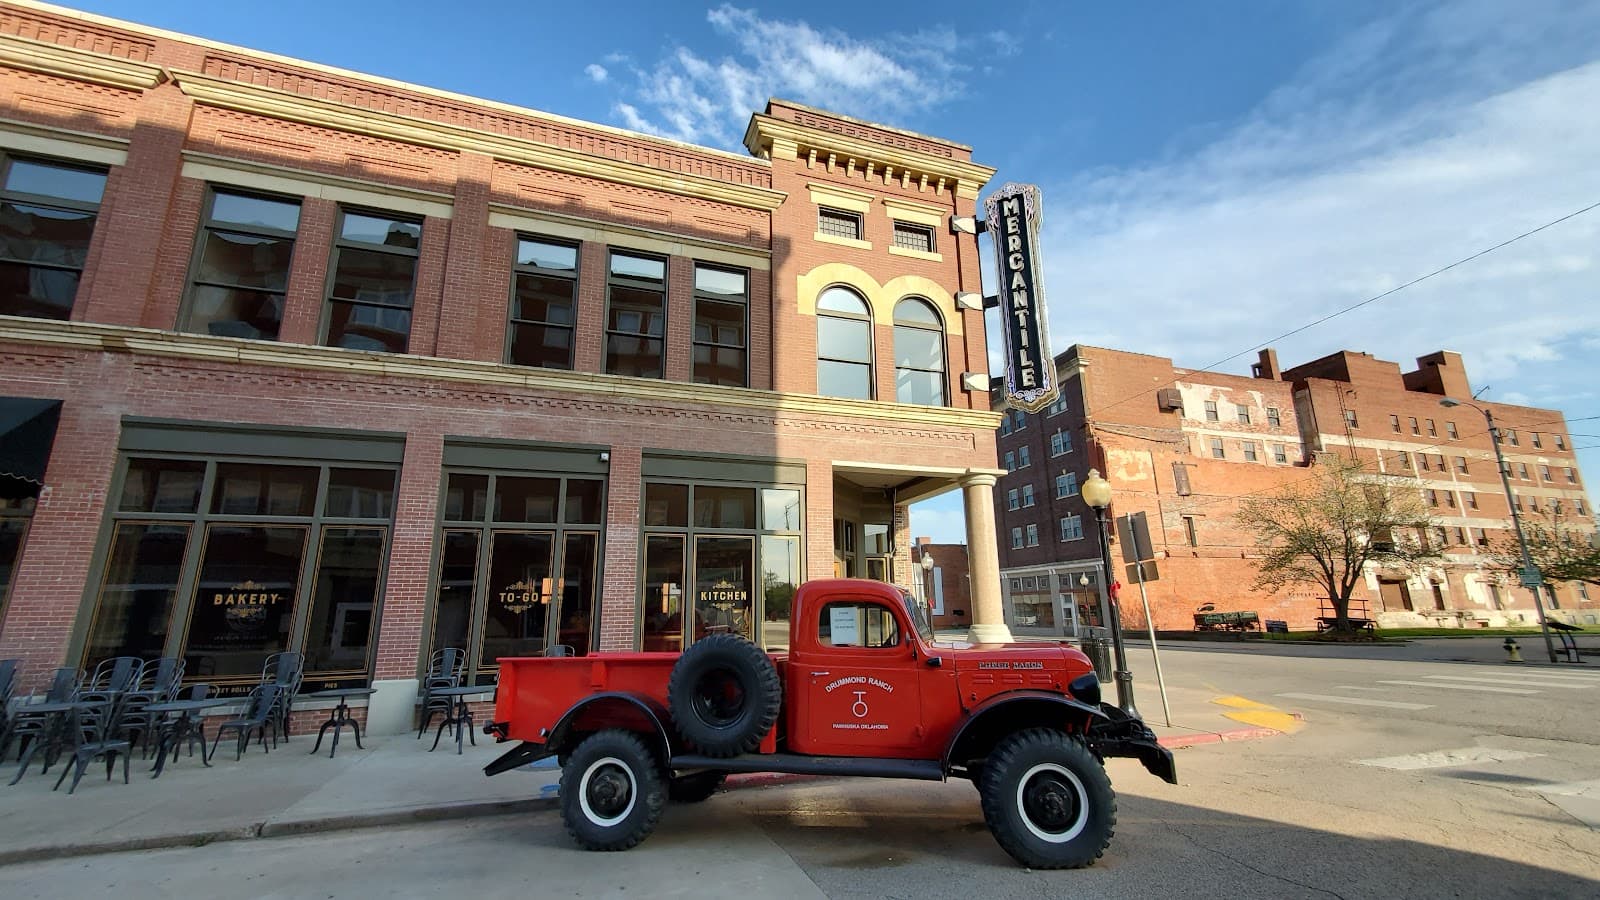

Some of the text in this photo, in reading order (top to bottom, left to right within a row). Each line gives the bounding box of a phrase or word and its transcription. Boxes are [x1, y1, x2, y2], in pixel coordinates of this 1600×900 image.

[1003, 197, 1036, 388] MERCANTILE
[213, 593, 279, 606] BAKERY
[499, 592, 539, 603] TO-GO
[700, 591, 747, 601] KITCHEN
[825, 676, 894, 693] DRUMMOND RANCH
